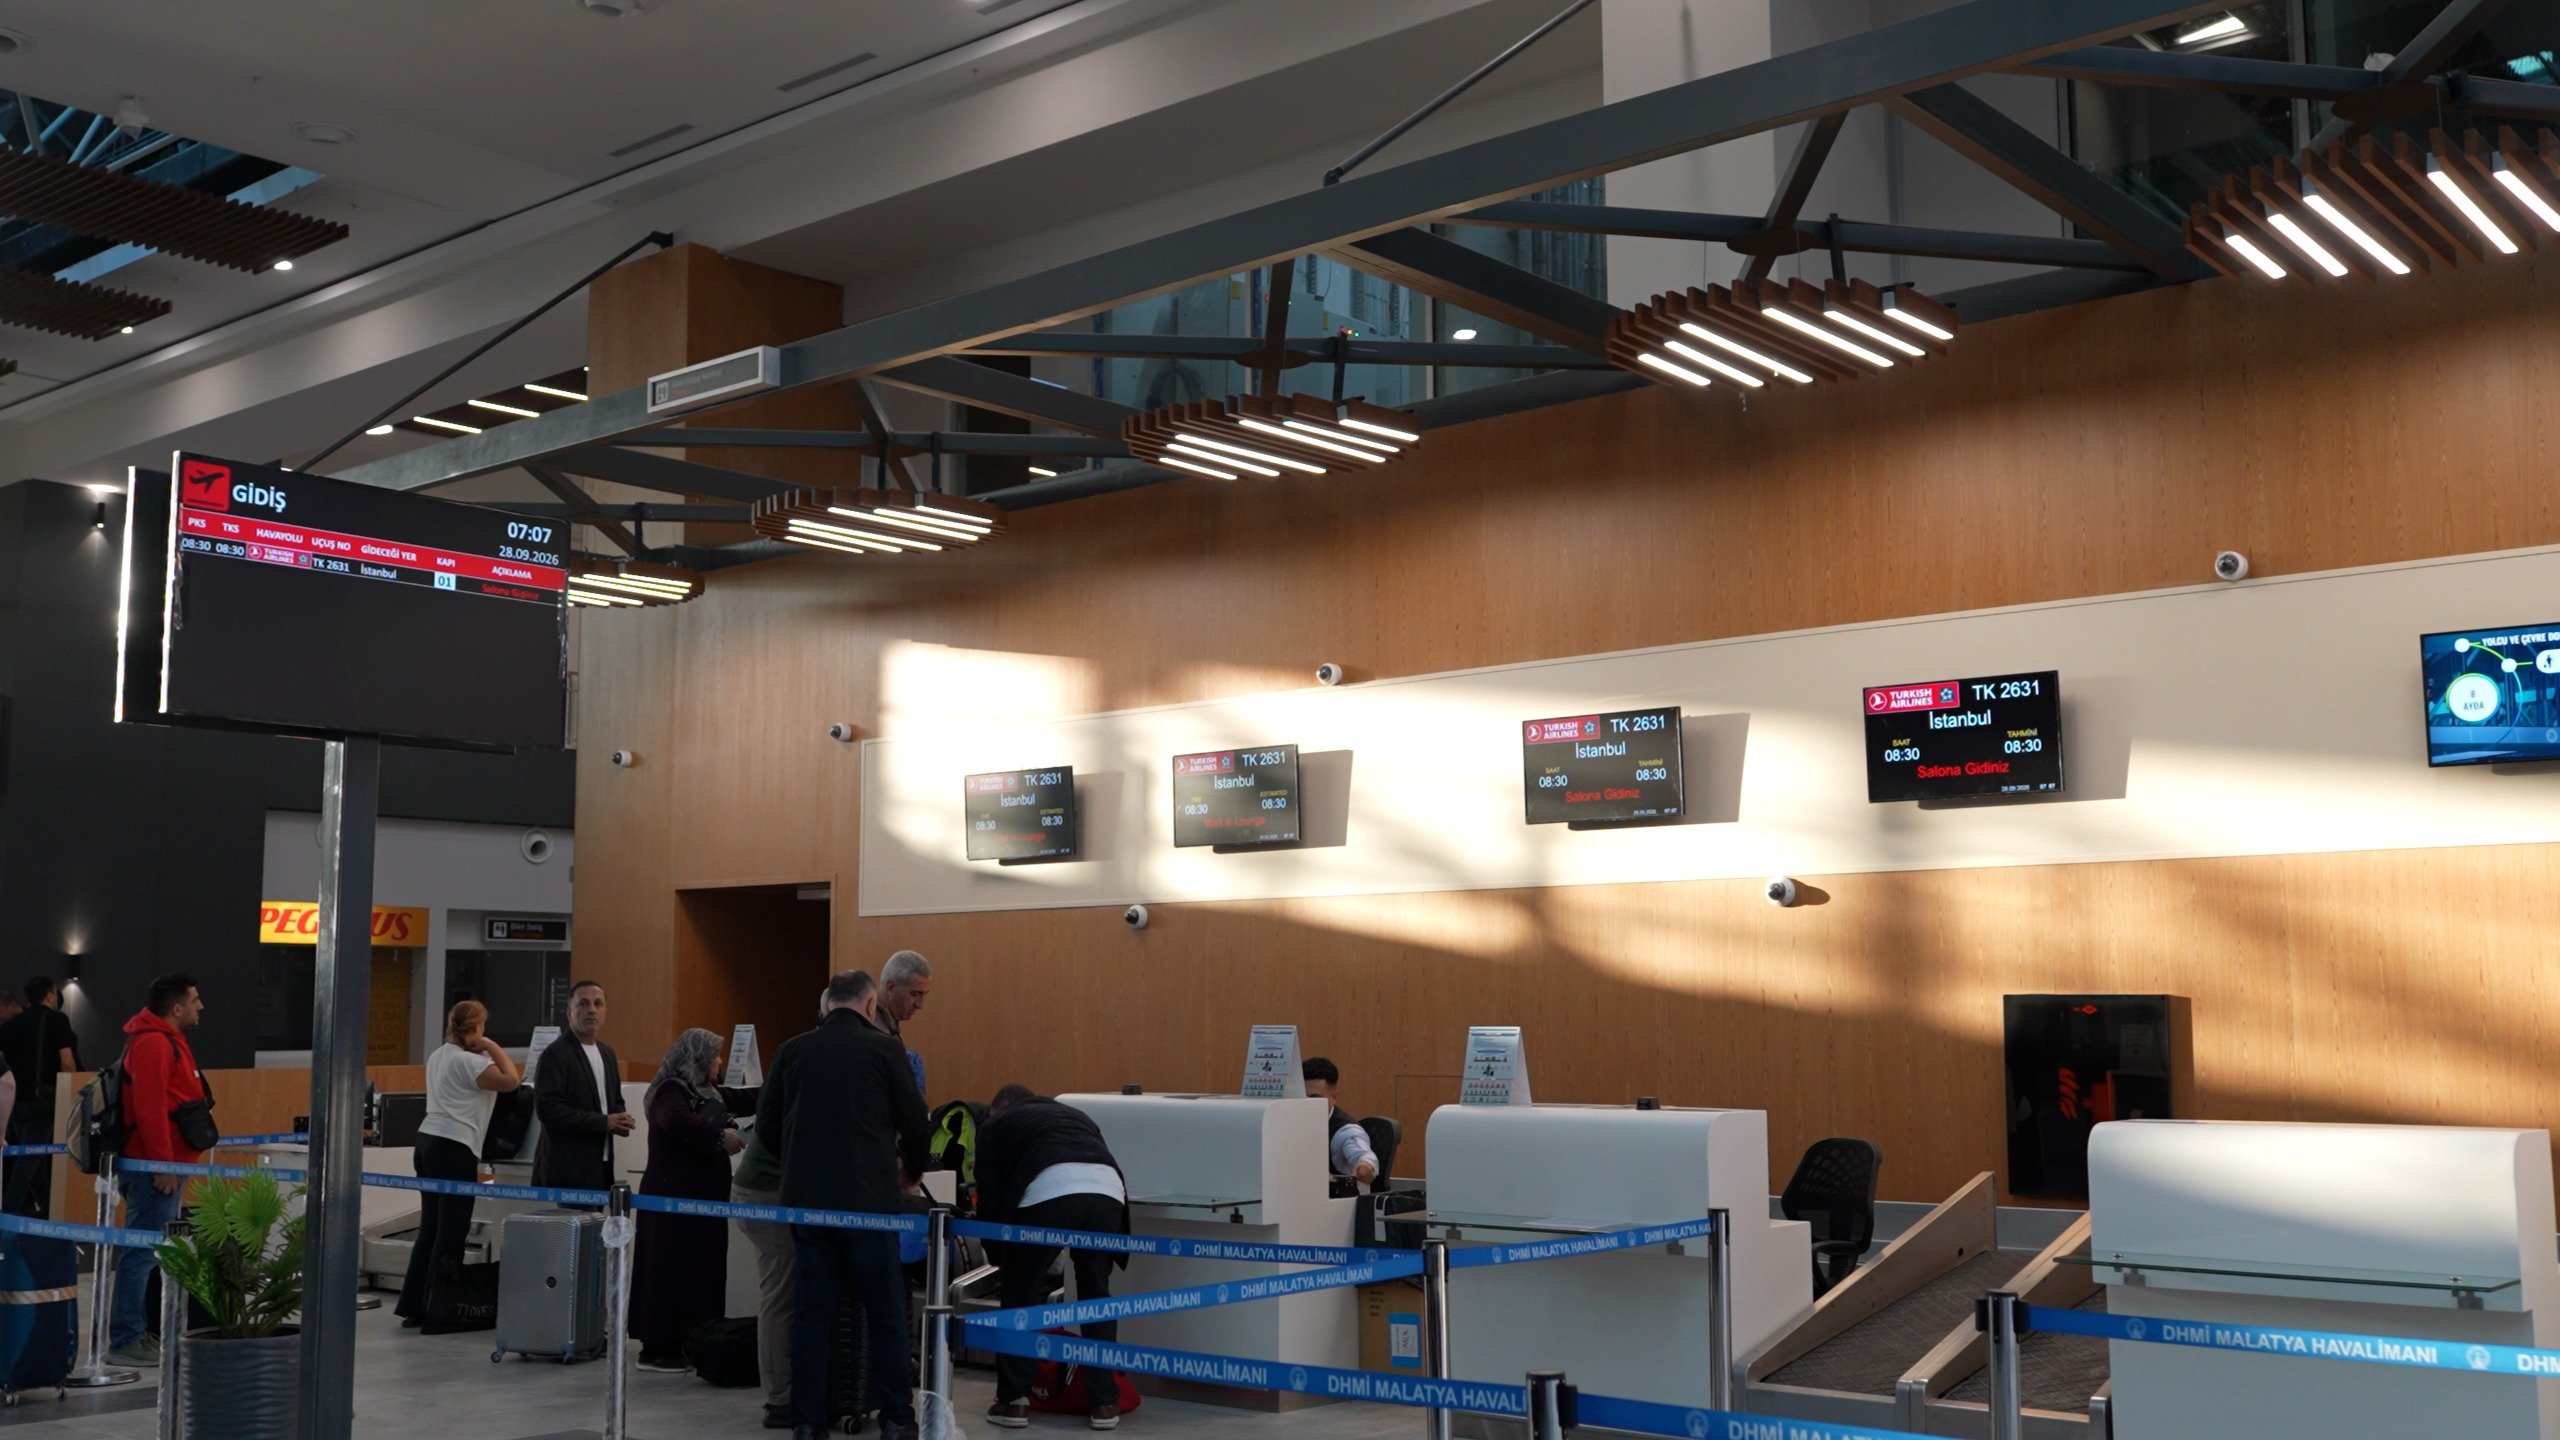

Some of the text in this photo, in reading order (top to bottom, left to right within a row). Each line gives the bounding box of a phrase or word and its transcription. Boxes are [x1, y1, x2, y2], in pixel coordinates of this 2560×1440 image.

[231, 482, 286, 512] GİDİŞ
[507, 522, 551, 543] 07:07
[181, 538, 245, 556] 08:30 08:30
[188, 517, 532, 580] PKS TKS HAVAYOLU UÇUŞ NO GİDECEĞİ YER KAPI AÇIKLAMA
[499, 545, 559, 566] 28.09.2026
[313, 558, 325, 568] TK
[326, 560, 349, 572] 2631
[361, 563, 397, 579] İstanbul
[438, 575, 451, 587] 01
[2482, 636, 2508, 647] YOLCU
[2509, 635, 2520, 644] VE
[2521, 633, 2547, 646] ÇEVRE
[1890, 688, 1932, 700] TURKISH
[1972, 680, 2039, 700] TK 2631
[1890, 697, 1933, 709] AIRLINES
[2463, 701, 2485, 711] AYDA
[1543, 721, 1578, 732] TURKISH
[1610, 715, 1665, 733] TK 2631
[1929, 709, 1992, 729] İstanbul
[1543, 729, 1579, 740] AIRLINES
[1892, 738, 1911, 747] SAAT
[1242, 751, 1286, 767] TK 2631
[1575, 741, 1626, 759] İstanbul
[1884, 738, 2042, 762] 08:30 08:30
[1024, 772, 1062, 786] TK 2631
[1539, 768, 1667, 788] 08:30 08:30
[1917, 760, 2010, 779] Salona Gidiniz
[1214, 774, 1255, 790] İstanbul
[1000, 793, 1036, 807] İstanbul
[1566, 787, 1641, 803] Salona Gidiniz
[1185, 797, 1287, 815] 08:30 08:30
[976, 815, 1063, 831] 08:30 08:30
[260, 908, 412, 941] PEGUS
[47, 1145, 68, 1153] MALA
[678, 1201, 777, 1220] DHMİ MALATYA HAVALİMANI
[803, 1212, 914, 1231] DHMİ MALATYA HAVALİMANI
[1020, 1229, 1157, 1252] DHMİ MALATYA HAVALİMANI
[1644, 1229, 1664, 1243] DHMİ
[1664, 1224, 1698, 1240] MALATYA
[1194, 1243, 1347, 1263] DHMİ MALATYA HAVALİMANI
[1508, 1234, 1618, 1261] DHMİ MALATYA HAVALİMANI
[1241, 1266, 1373, 1299] DHMİ MALATYA HAVALİMANI
[1043, 1290, 1200, 1326] DHMİ MALATYA HAVALİMANI
[2162, 1323, 2437, 1365] DHMİ MALATYA HAVALİMANI
[1063, 1340, 1268, 1386] DHMİ MALATYA HAVALİMANI
[2516, 1353, 2560, 1374] DHM
[1327, 1373, 1527, 1413] DHMİ MALATYA HAVALİ
[1728, 1420, 1783, 1440] DHMİ
